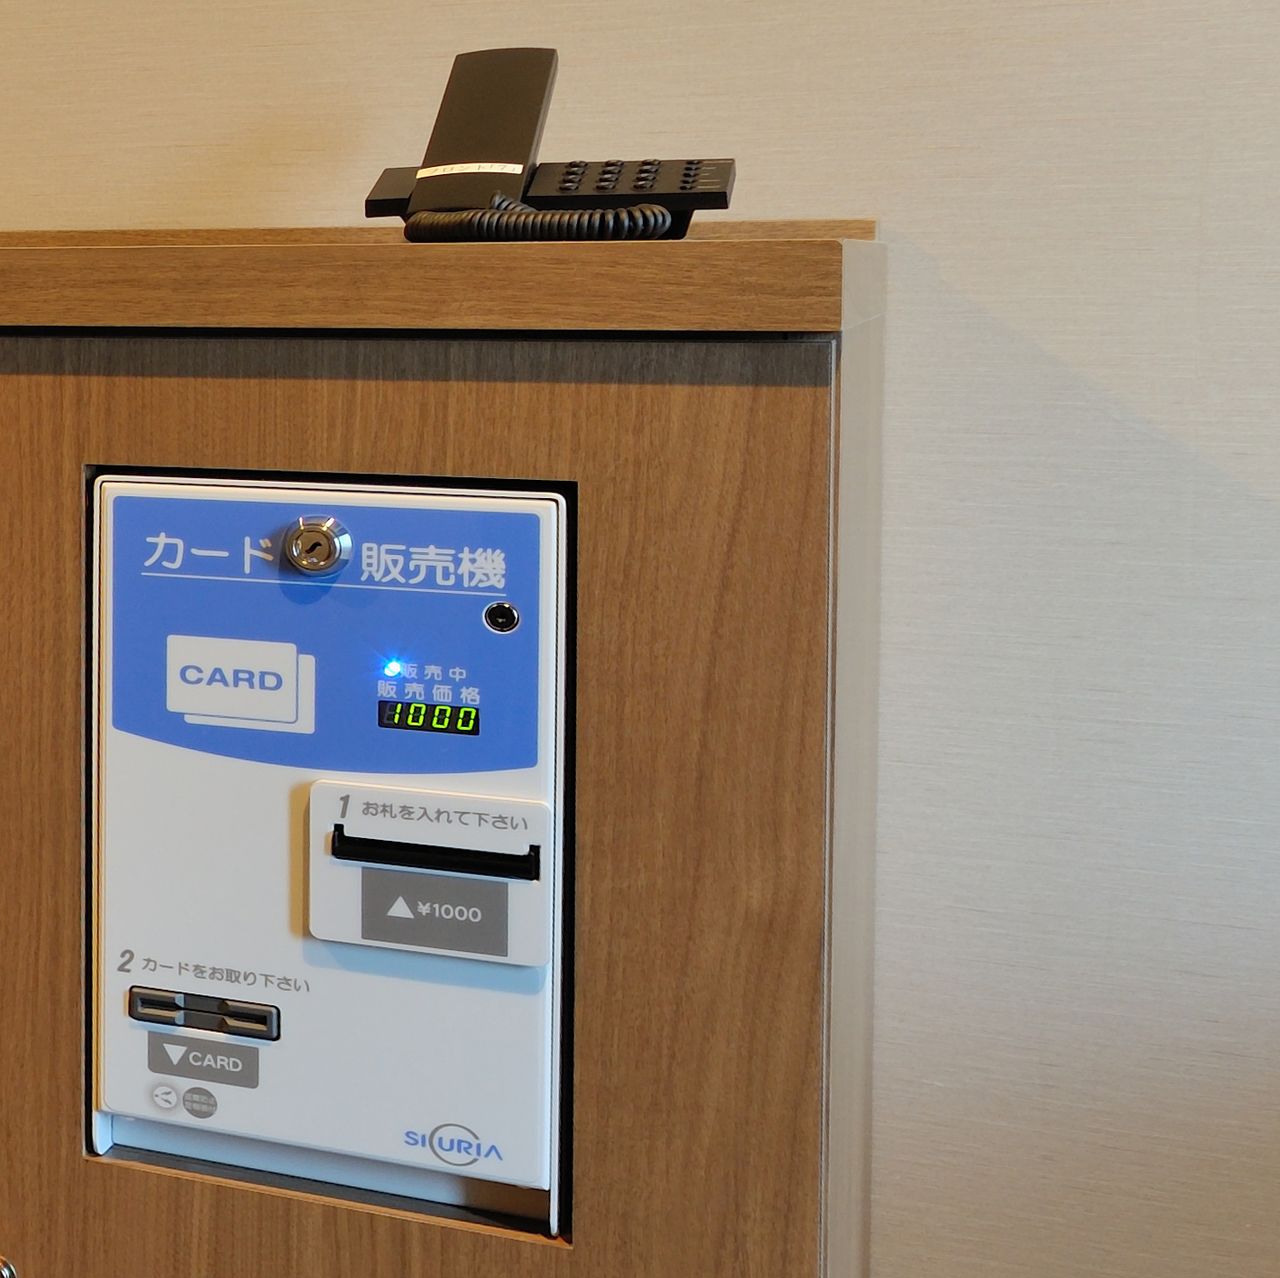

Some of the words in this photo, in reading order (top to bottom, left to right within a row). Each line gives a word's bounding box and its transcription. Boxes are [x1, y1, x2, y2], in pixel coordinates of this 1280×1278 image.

[144, 531, 274, 574] カード
[360, 541, 507, 590] 販売機
[179, 664, 283, 692] CARD
[401, 663, 466, 682] 販売中
[378, 680, 480, 705] 販売価格
[394, 703, 476, 731] 1000
[339, 794, 351, 819] 1
[362, 800, 528, 831] お札を入れて下さい
[417, 900, 482, 923] ¥1000
[117, 949, 135, 973] 2
[141, 957, 310, 993] カードをお取り下さい
[189, 1051, 242, 1072] CARD
